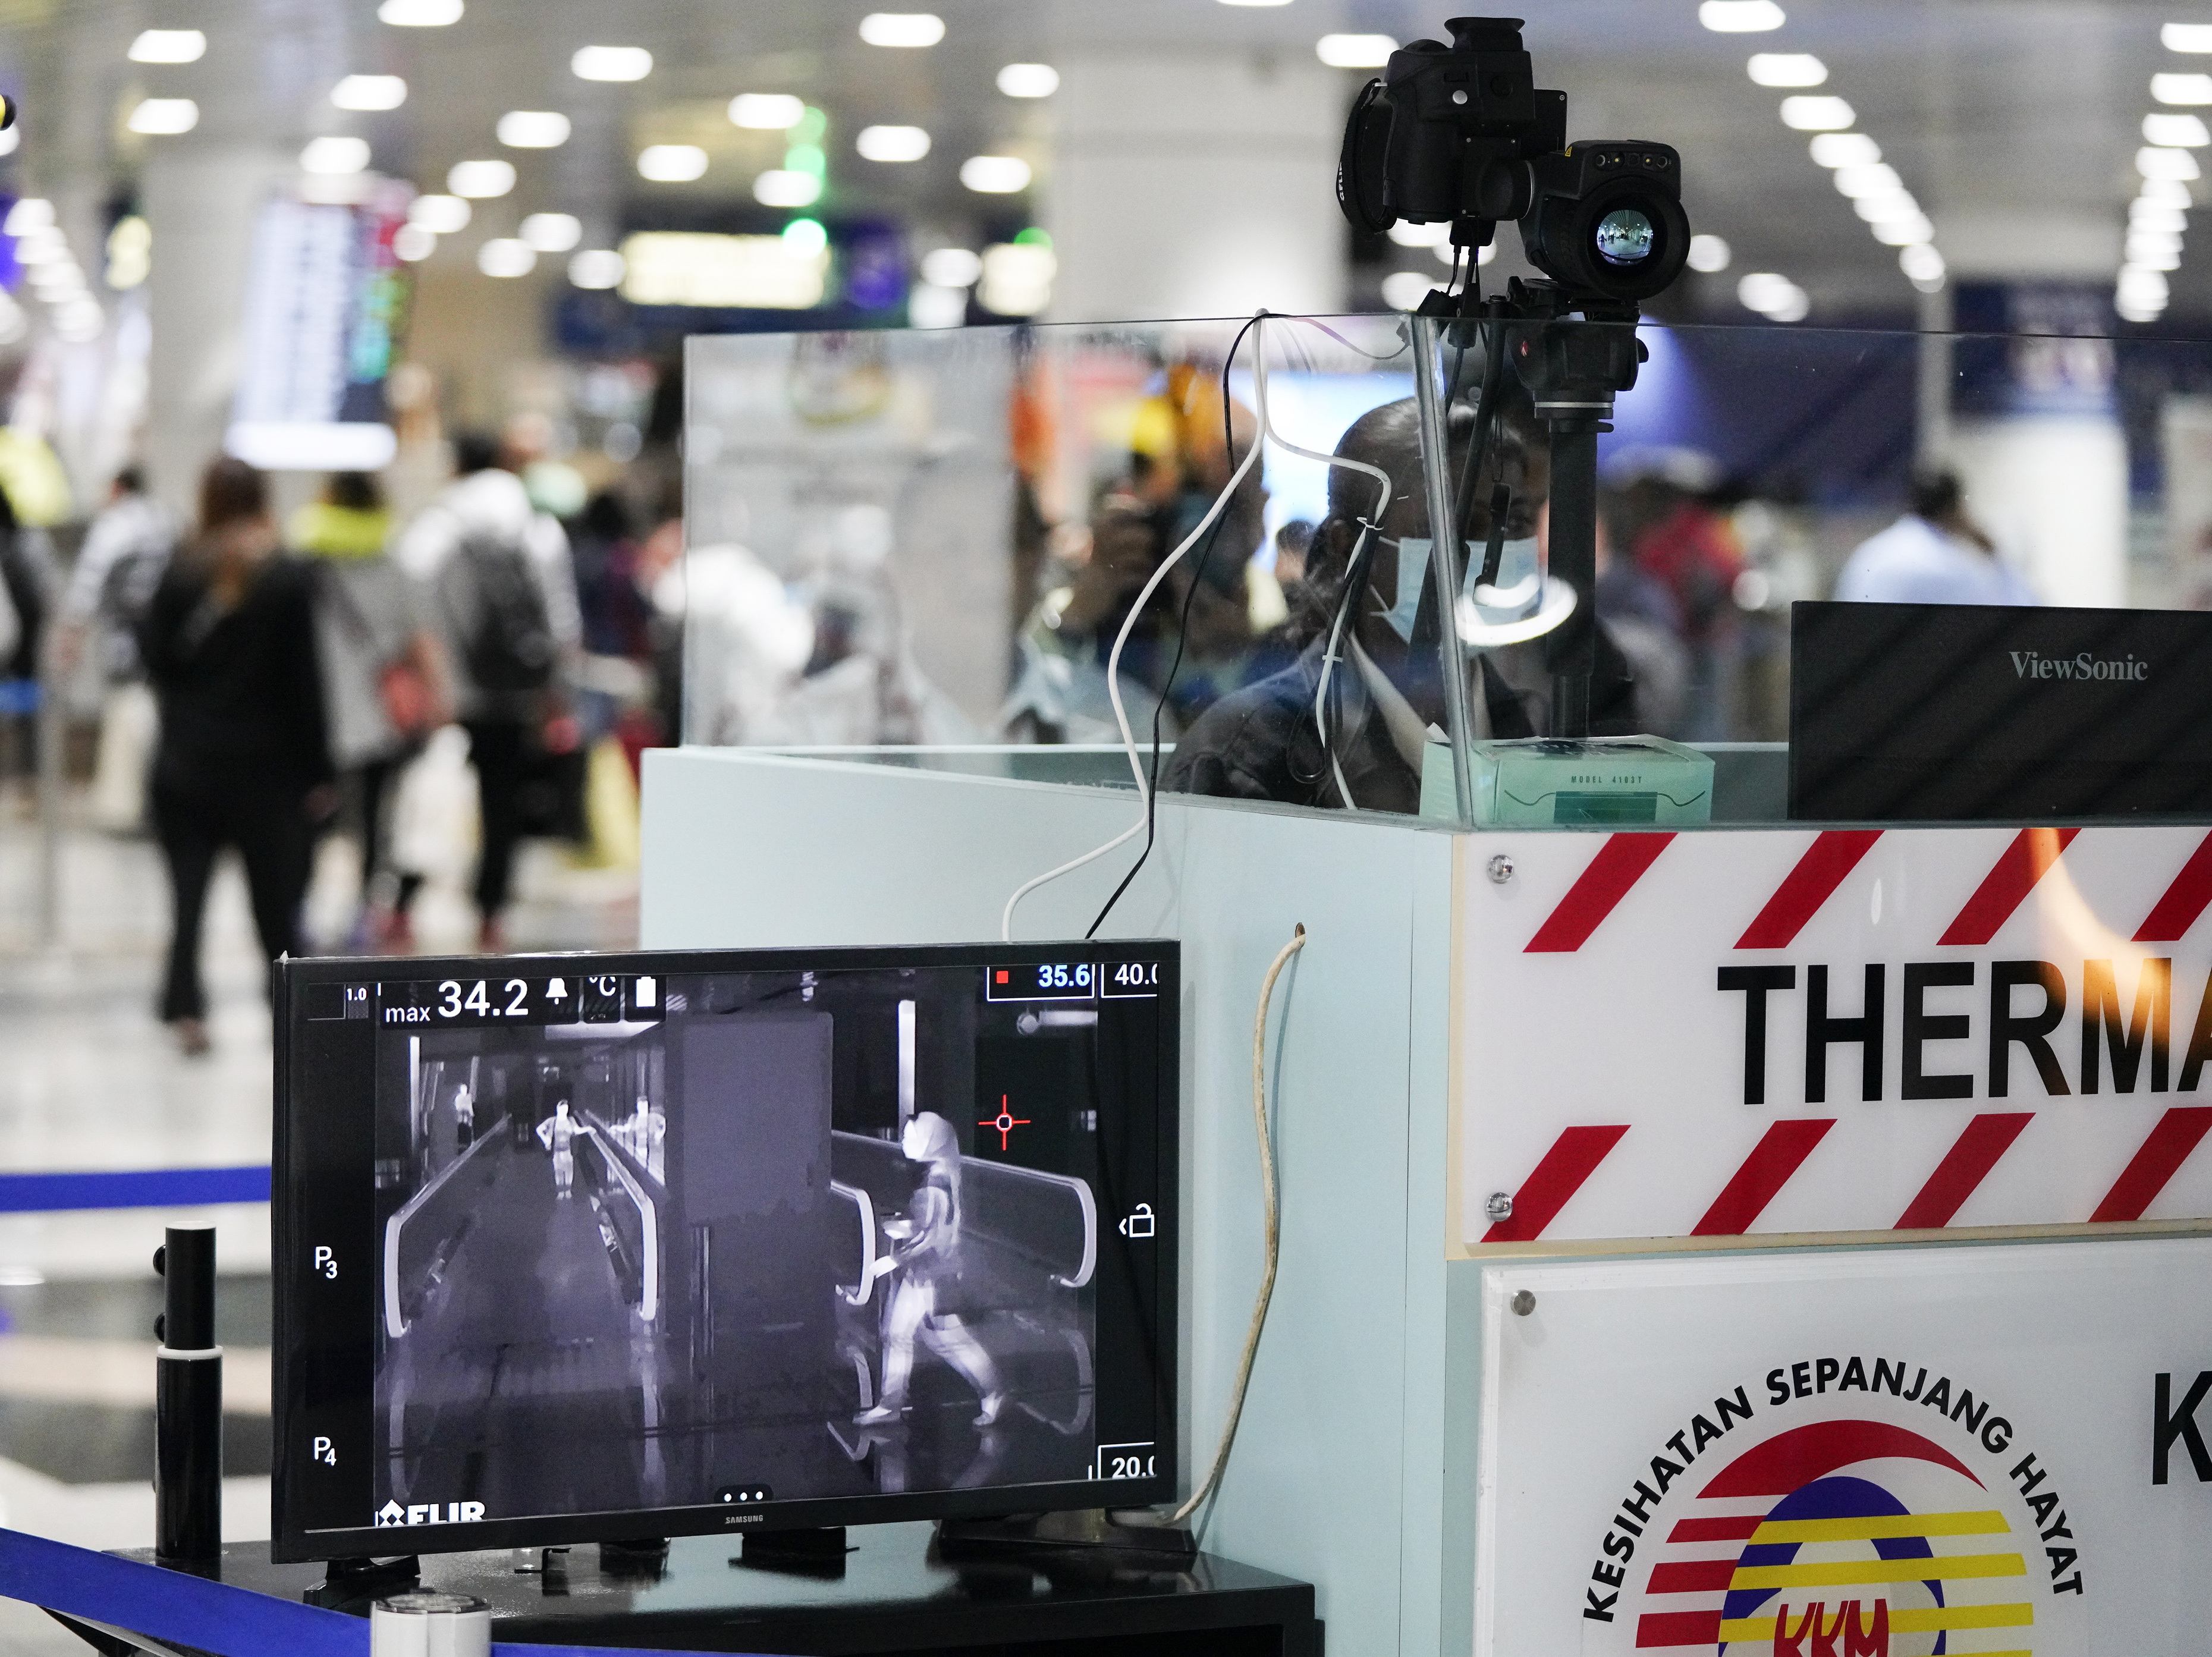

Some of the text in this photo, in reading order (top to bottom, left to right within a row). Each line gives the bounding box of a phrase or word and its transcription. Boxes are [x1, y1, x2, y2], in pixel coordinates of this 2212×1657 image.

[2009, 651, 2148, 681] ViewSonic
[1571, 775, 1603, 784] MODEL
[1038, 964, 1091, 987] 35.6
[347, 987, 367, 1001] 1.0
[385, 979, 529, 1023] max 34.2
[315, 1246, 338, 1279] P3
[2152, 1370, 2212, 1486] K
[314, 1436, 337, 1466] P4
[1583, 1356, 2083, 1623] KESIHATAN SEPANJANG HAYAT
[725, 1514, 763, 1524] SAMSUNG
[1774, 1599, 1889, 1657] KKM
